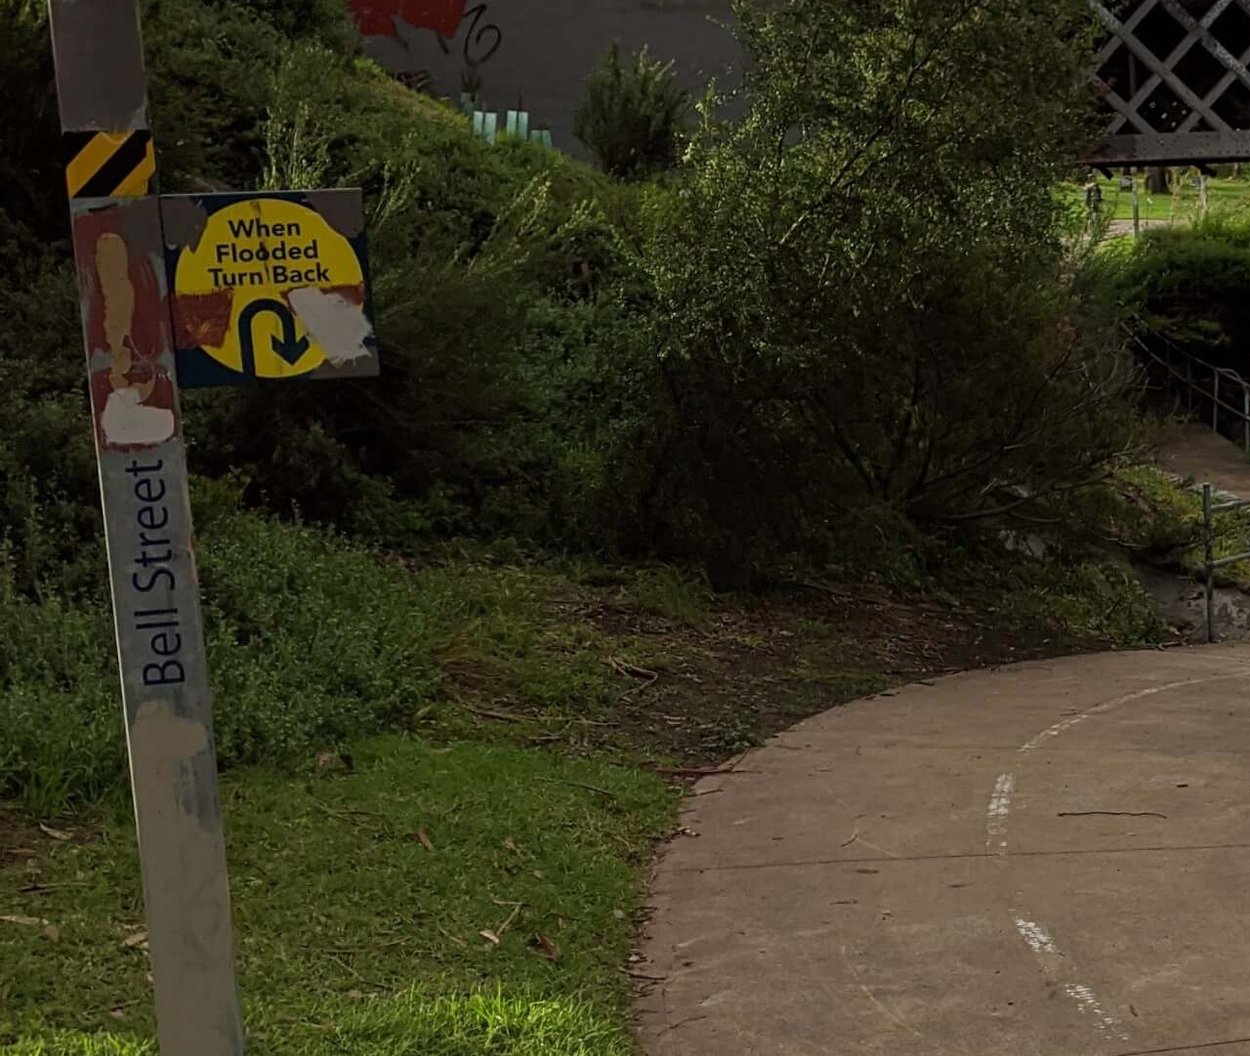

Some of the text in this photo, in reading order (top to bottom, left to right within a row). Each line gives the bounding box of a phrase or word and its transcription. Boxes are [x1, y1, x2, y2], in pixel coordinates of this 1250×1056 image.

[228, 219, 301, 239] When
[216, 240, 319, 263] Flooded
[208, 263, 330, 288] Turn Back
[125, 459, 185, 686] Bell Street
